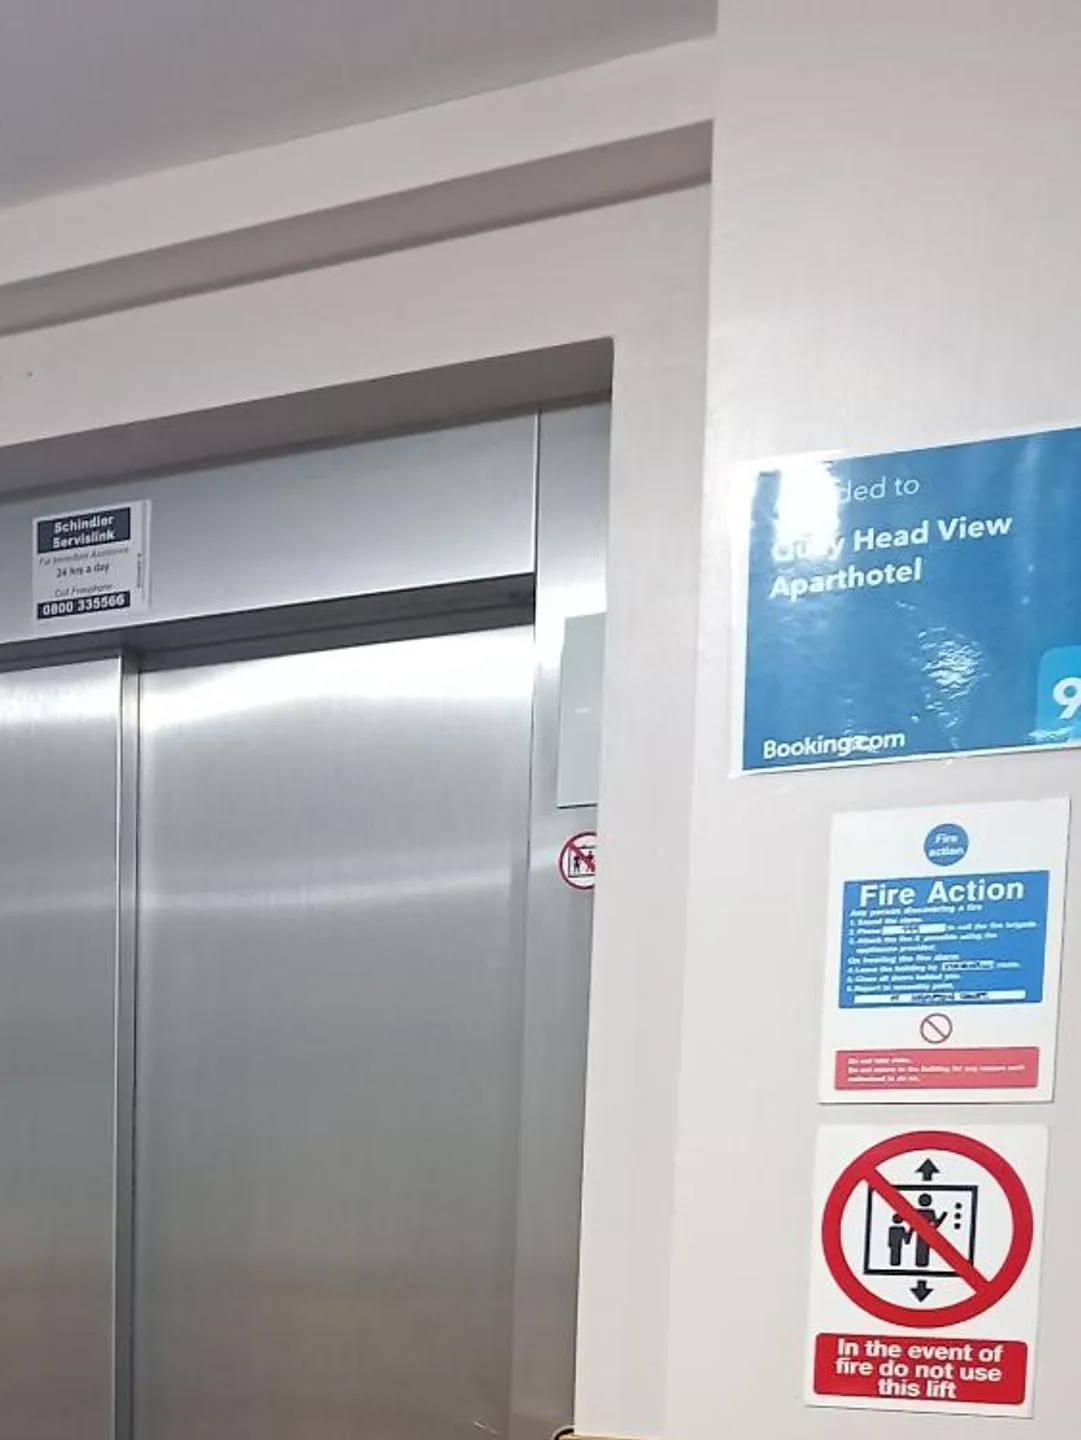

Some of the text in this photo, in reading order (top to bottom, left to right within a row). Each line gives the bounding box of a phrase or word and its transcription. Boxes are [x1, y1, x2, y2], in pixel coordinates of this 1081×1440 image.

[895, 477, 920, 497] to
[54, 514, 114, 534] Schindler
[853, 519, 930, 552] Head
[937, 515, 1013, 542] View
[52, 529, 116, 548] Servislink
[768, 557, 923, 601] Aparthotel
[42, 600, 73, 616] 0800
[763, 732, 906, 760] Booking.com
[860, 878, 1024, 907] Fire Action
[837, 1338, 1004, 1363] In the event of
[835, 1357, 1002, 1382] fire do not use
[877, 1378, 957, 1399] this lift
